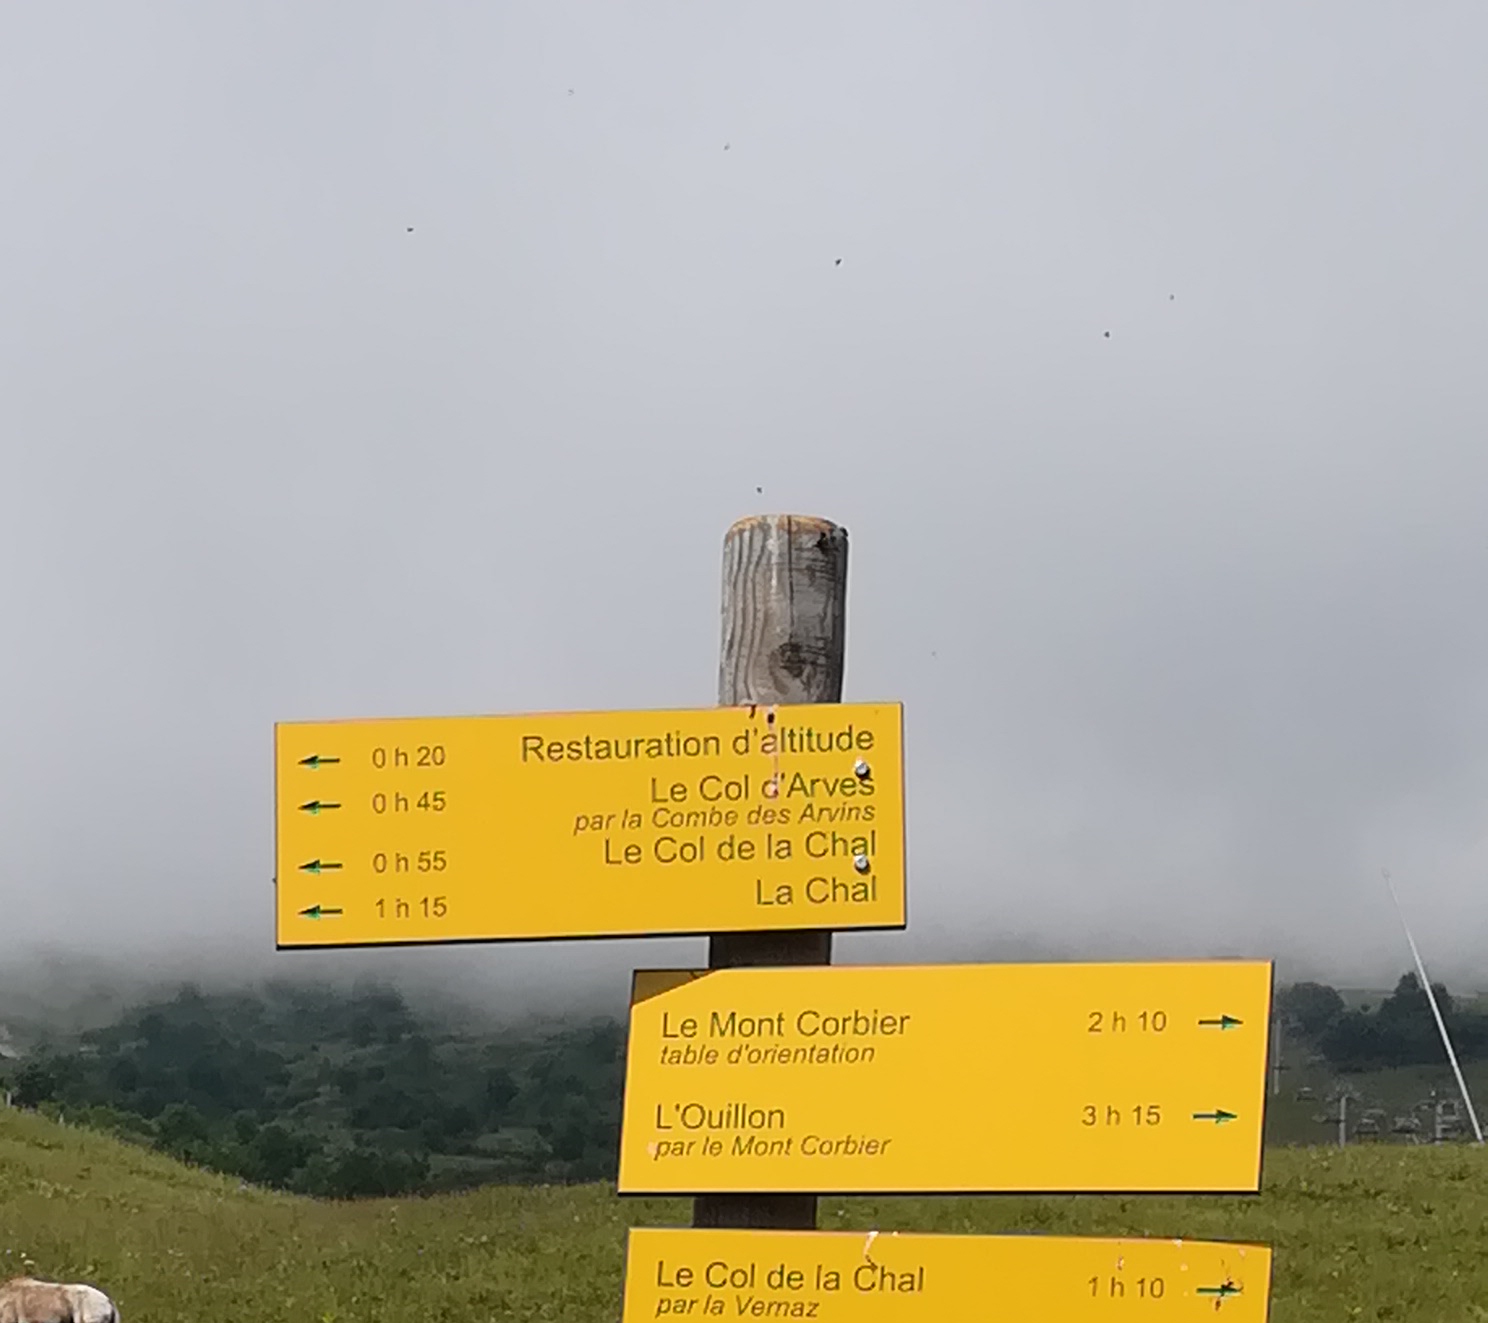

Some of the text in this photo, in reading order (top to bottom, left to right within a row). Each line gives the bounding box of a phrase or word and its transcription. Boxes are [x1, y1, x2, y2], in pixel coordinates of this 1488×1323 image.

[522, 725, 874, 762] Restauration d'altitude
[372, 746, 445, 768] 0 h 20
[652, 766, 874, 803] Le Col d'Arves
[373, 791, 446, 814] 0 h 45
[574, 802, 875, 836] par la Combe des Arvins
[605, 830, 875, 864] Le Col de la Chal
[373, 851, 446, 873] 0 h 55
[757, 875, 876, 905] La Chal
[376, 896, 447, 918] 1 h 15
[663, 1009, 910, 1038] Le Mont Corbier
[1088, 1011, 1166, 1032] 2 h 10
[661, 1044, 874, 1064] table d'orientation
[657, 1103, 784, 1129] L'Ouillon
[1082, 1105, 1160, 1126] 3 h 15
[654, 1135, 892, 1161] par le Mont Corbier
[658, 1260, 923, 1292] Le Col de la Chal
[1089, 1277, 1164, 1298] 1 h 10
[655, 1294, 819, 1318] par la Vernaz
